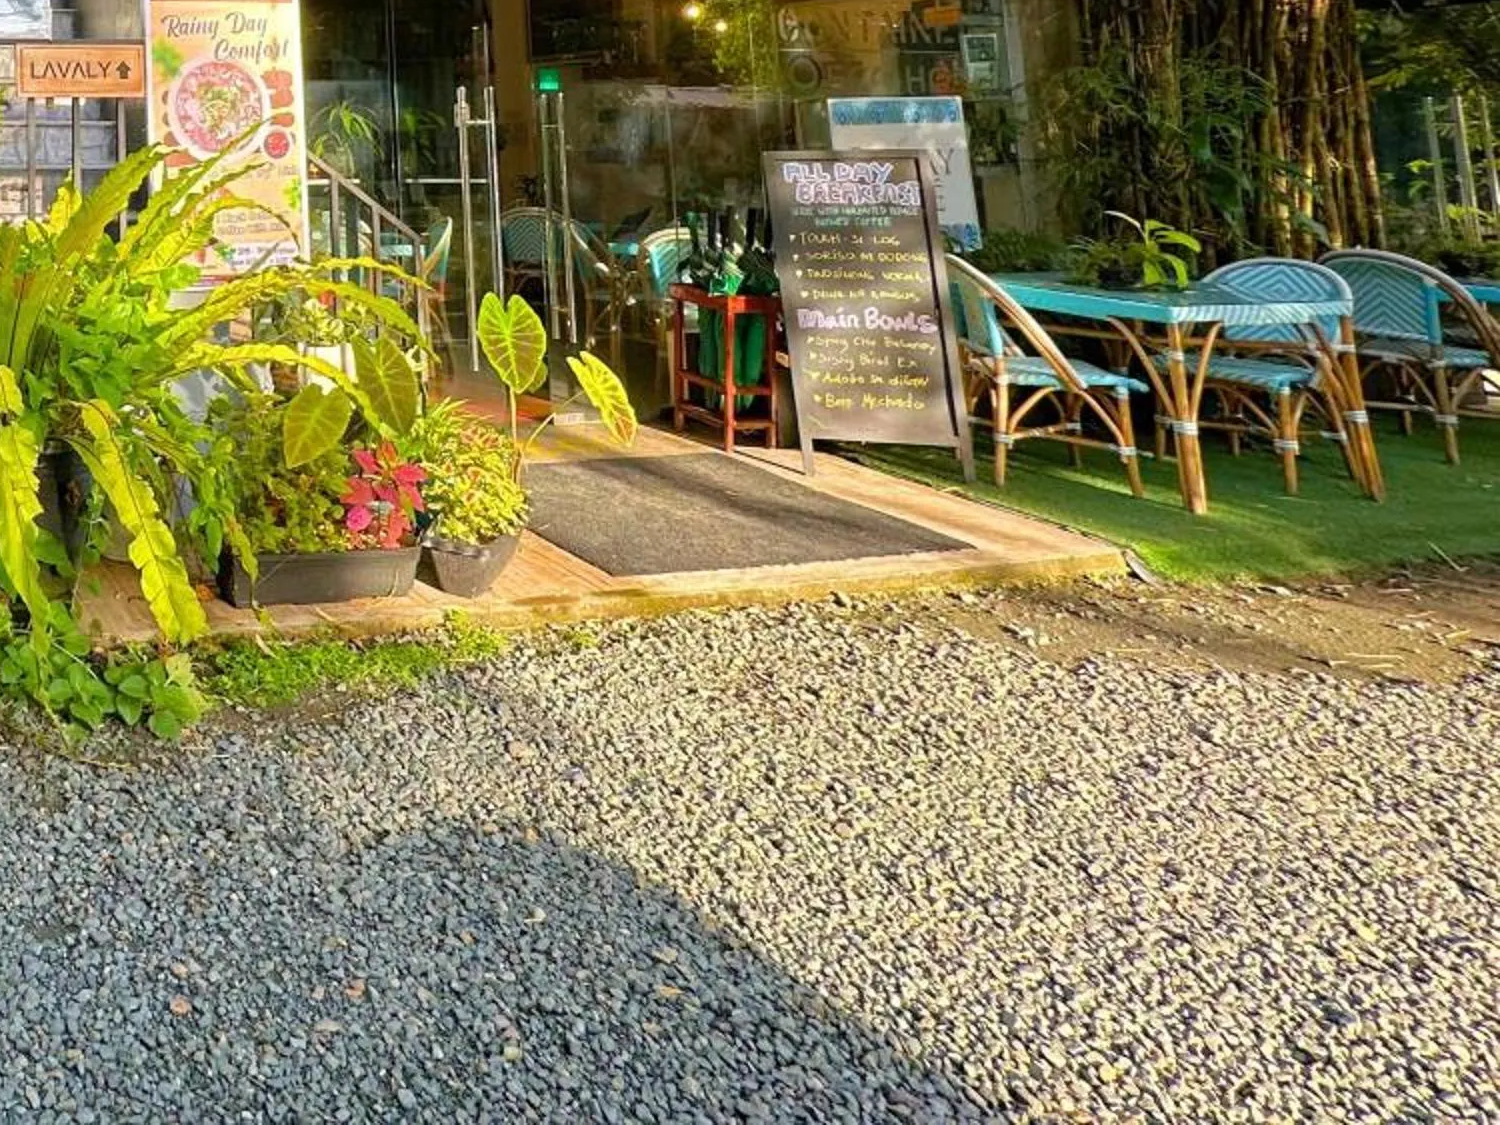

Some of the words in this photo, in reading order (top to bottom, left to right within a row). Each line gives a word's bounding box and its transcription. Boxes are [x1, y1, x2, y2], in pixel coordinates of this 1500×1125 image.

[161, 13, 220, 40] Rainy
[225, 10, 268, 38] Day
[213, 37, 289, 65] Comfort
[30, 60, 112, 80] LAVALY
[833, 161, 894, 185] DAY
